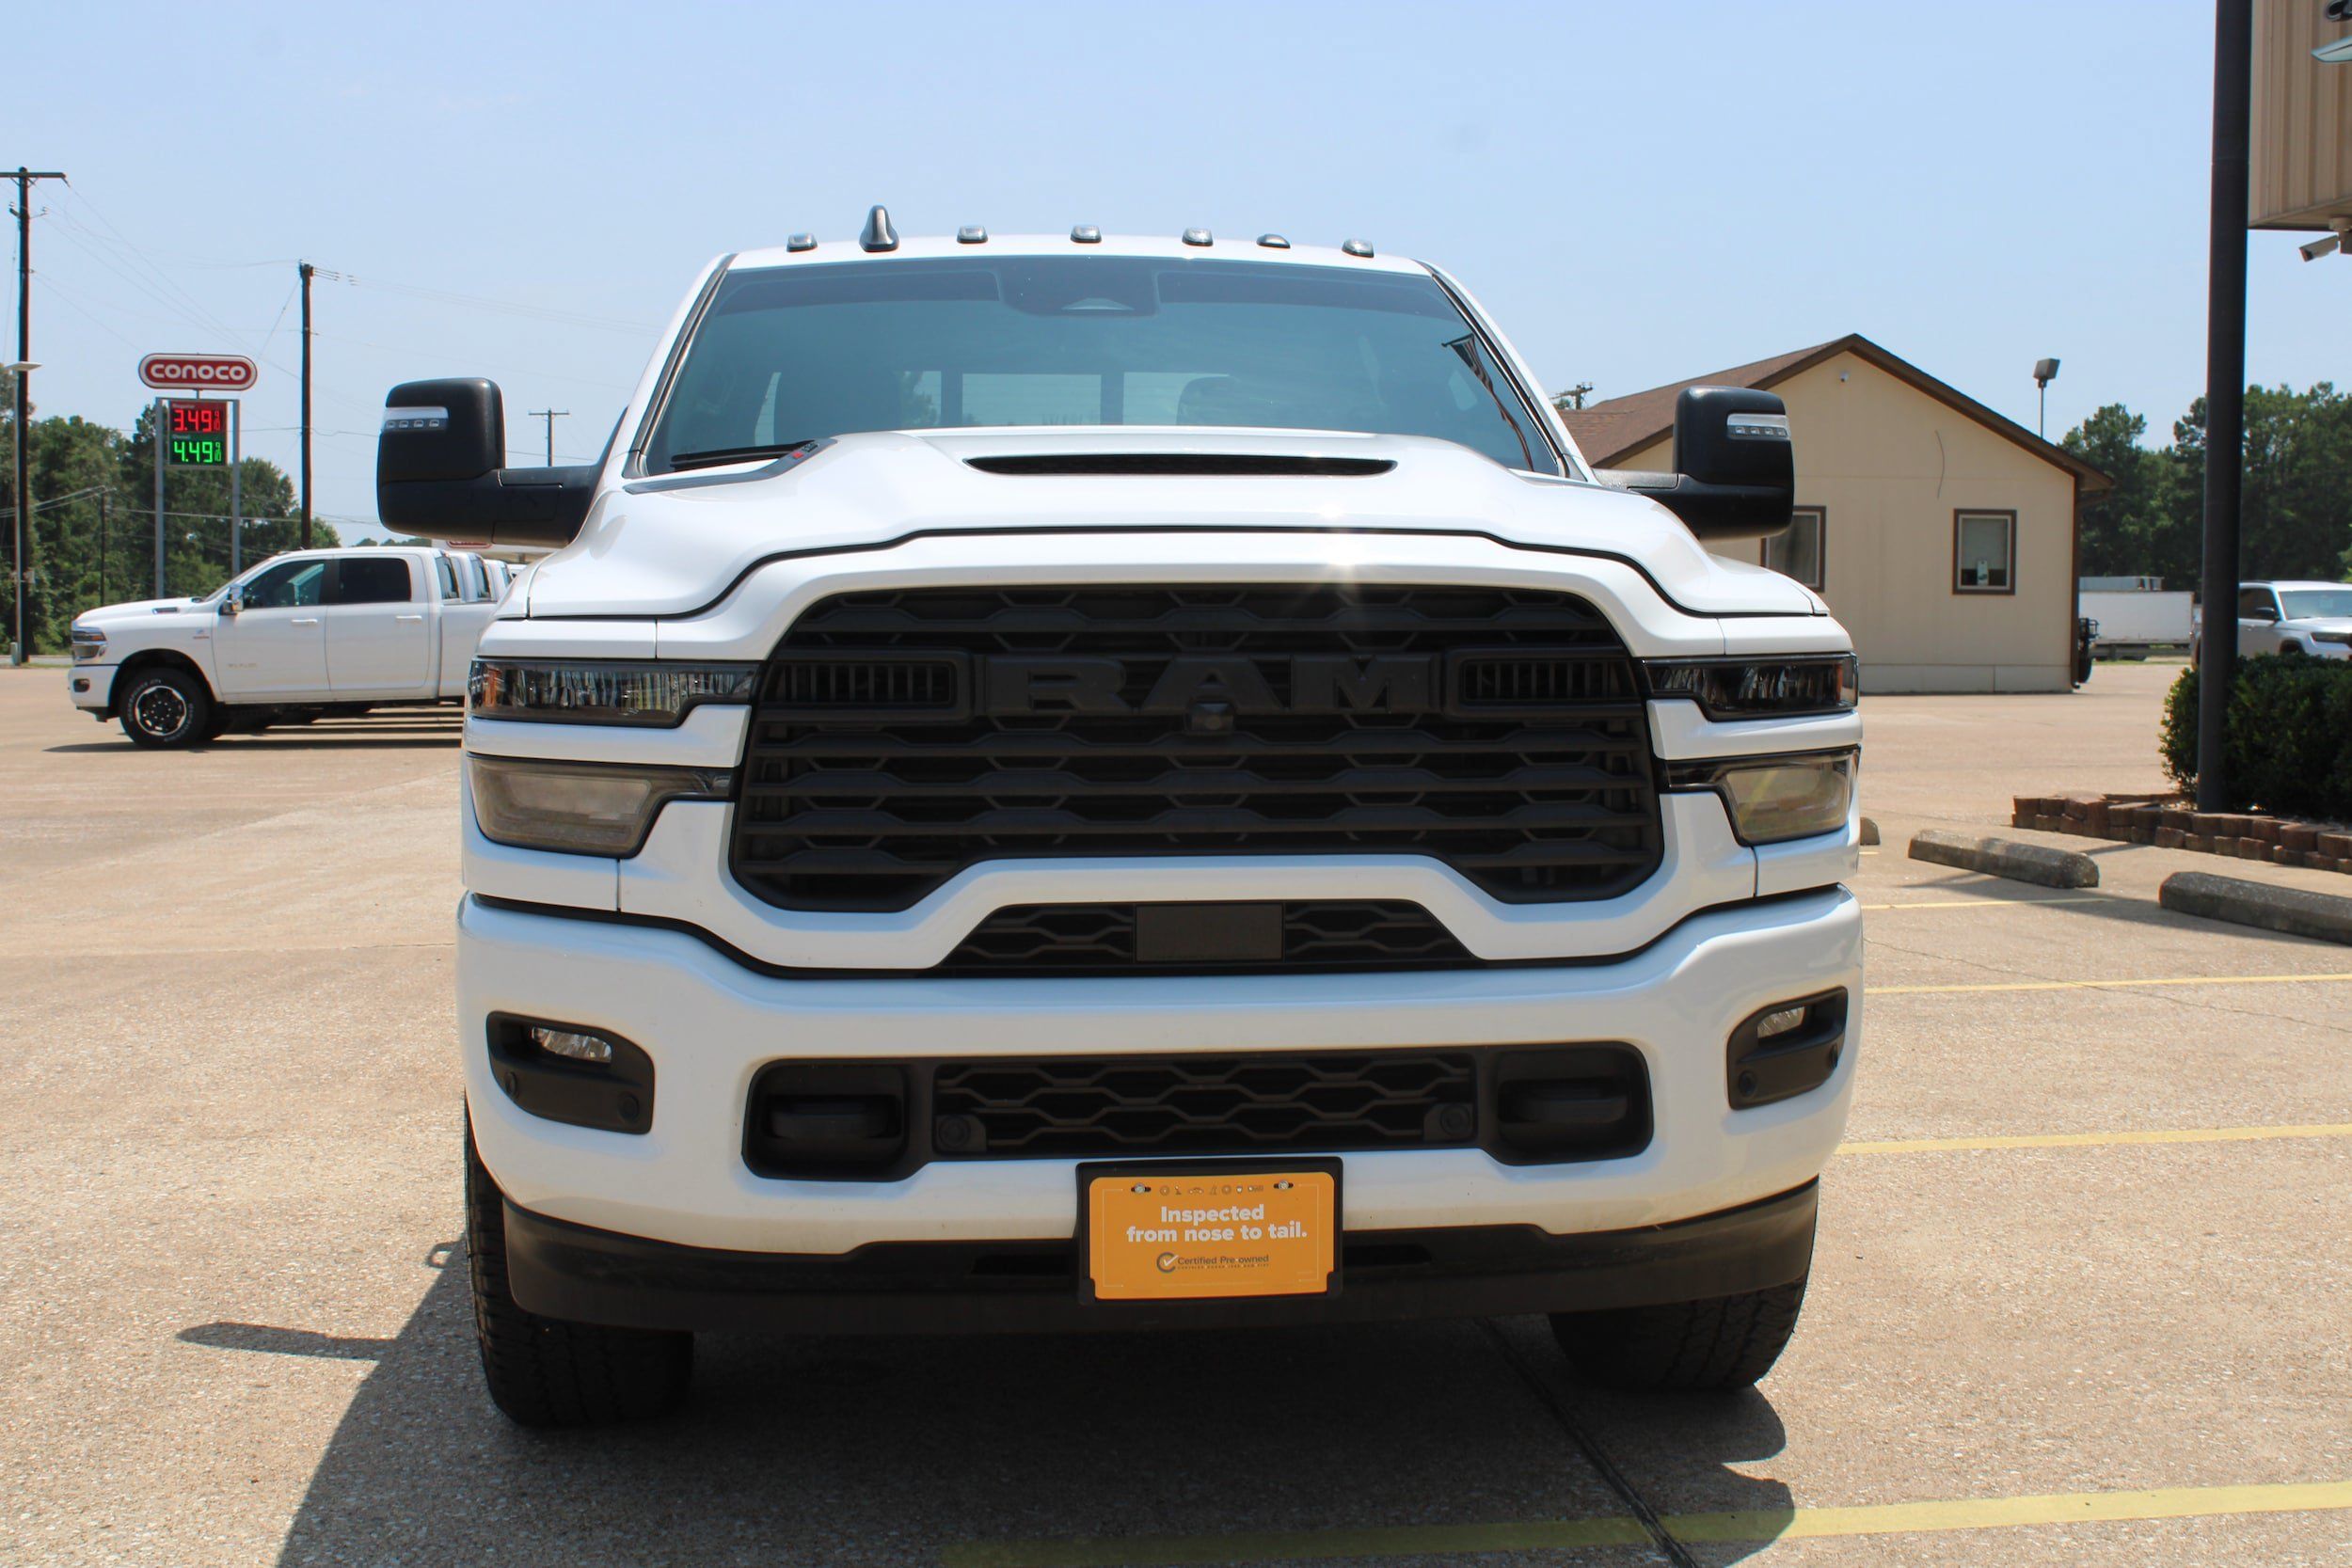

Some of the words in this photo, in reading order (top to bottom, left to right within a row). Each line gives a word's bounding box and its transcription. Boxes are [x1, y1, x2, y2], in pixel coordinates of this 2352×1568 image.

[985, 654, 1432, 716] RAM
[1160, 1203, 1264, 1226] Inspected
[1126, 1226, 1178, 1243] from
[1184, 1226, 1234, 1242] nose
[1240, 1224, 1263, 1241] to
[1268, 1220, 1308, 1239] tail.
[1177, 1256, 1217, 1265] Certified
